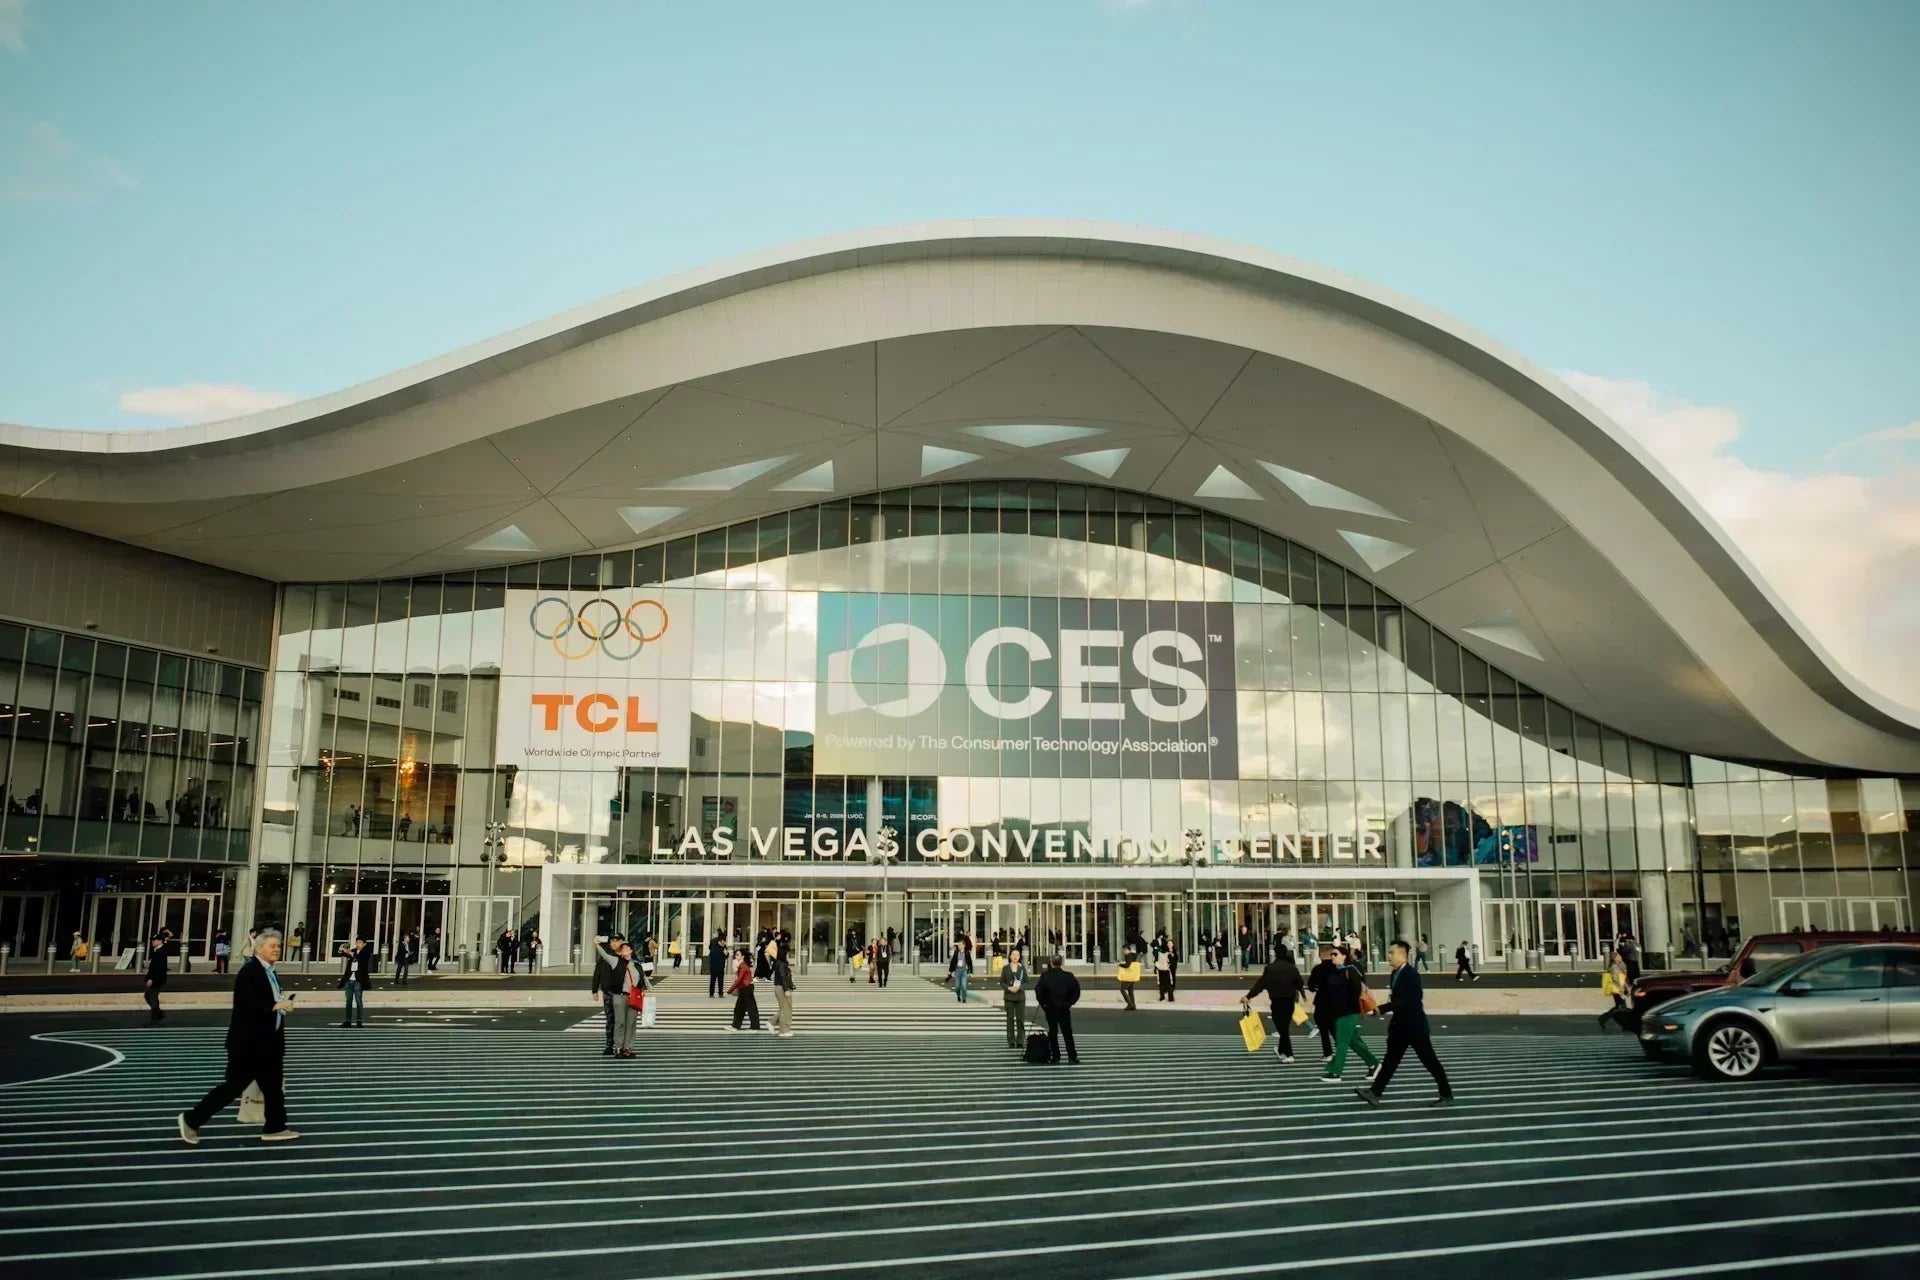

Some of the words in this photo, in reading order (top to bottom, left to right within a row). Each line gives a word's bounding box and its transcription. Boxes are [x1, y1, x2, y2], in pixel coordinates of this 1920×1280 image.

[532, 693, 657, 733] TCL
[524, 747, 578, 757] Worldwide
[580, 748, 620, 759] Olympic
[623, 749, 661, 758] Partner
[826, 734, 893, 749] Powered
[897, 735, 915, 752] by
[918, 735, 947, 749] The
[951, 736, 1030, 750] Consumer
[1033, 737, 1119, 754] Technology
[653, 826, 734, 856] LAS
[751, 827, 899, 857] VEGAS
[1220, 830, 1382, 859] CENTER
